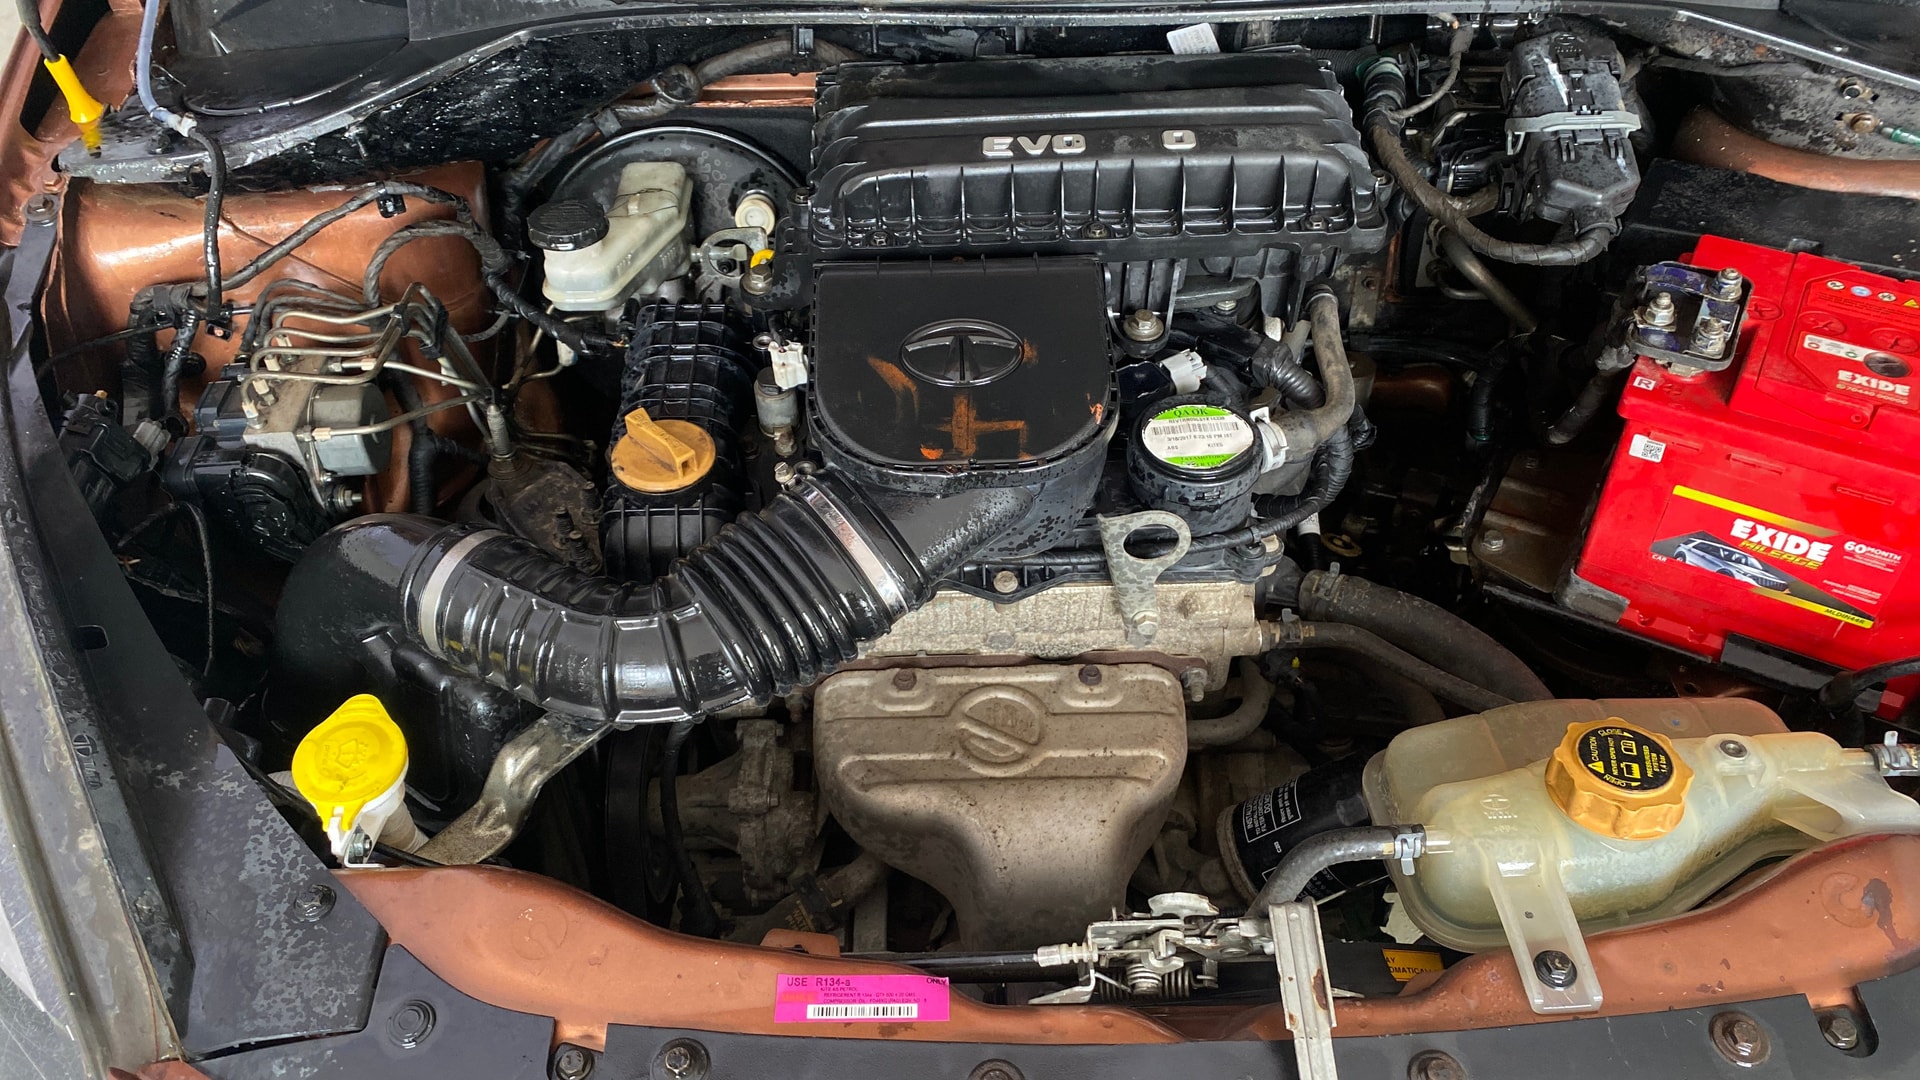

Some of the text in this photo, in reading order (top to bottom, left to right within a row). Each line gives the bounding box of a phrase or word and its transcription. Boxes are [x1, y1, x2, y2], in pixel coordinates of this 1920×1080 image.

[1636, 377, 1653, 390] R
[1837, 369, 1912, 396] EXIDE
[1174, 410, 1190, 418] QA
[1729, 518, 1834, 562] EXIDE
[1651, 554, 1668, 563] CAR
[1738, 539, 1824, 571] MILEAGE
[1843, 540, 1867, 555] 60
[1865, 546, 1902, 561] MONTH
[1589, 735, 1599, 762] CAUTION
[786, 977, 851, 987] USE R134-a
[926, 977, 947, 986] ONLY
